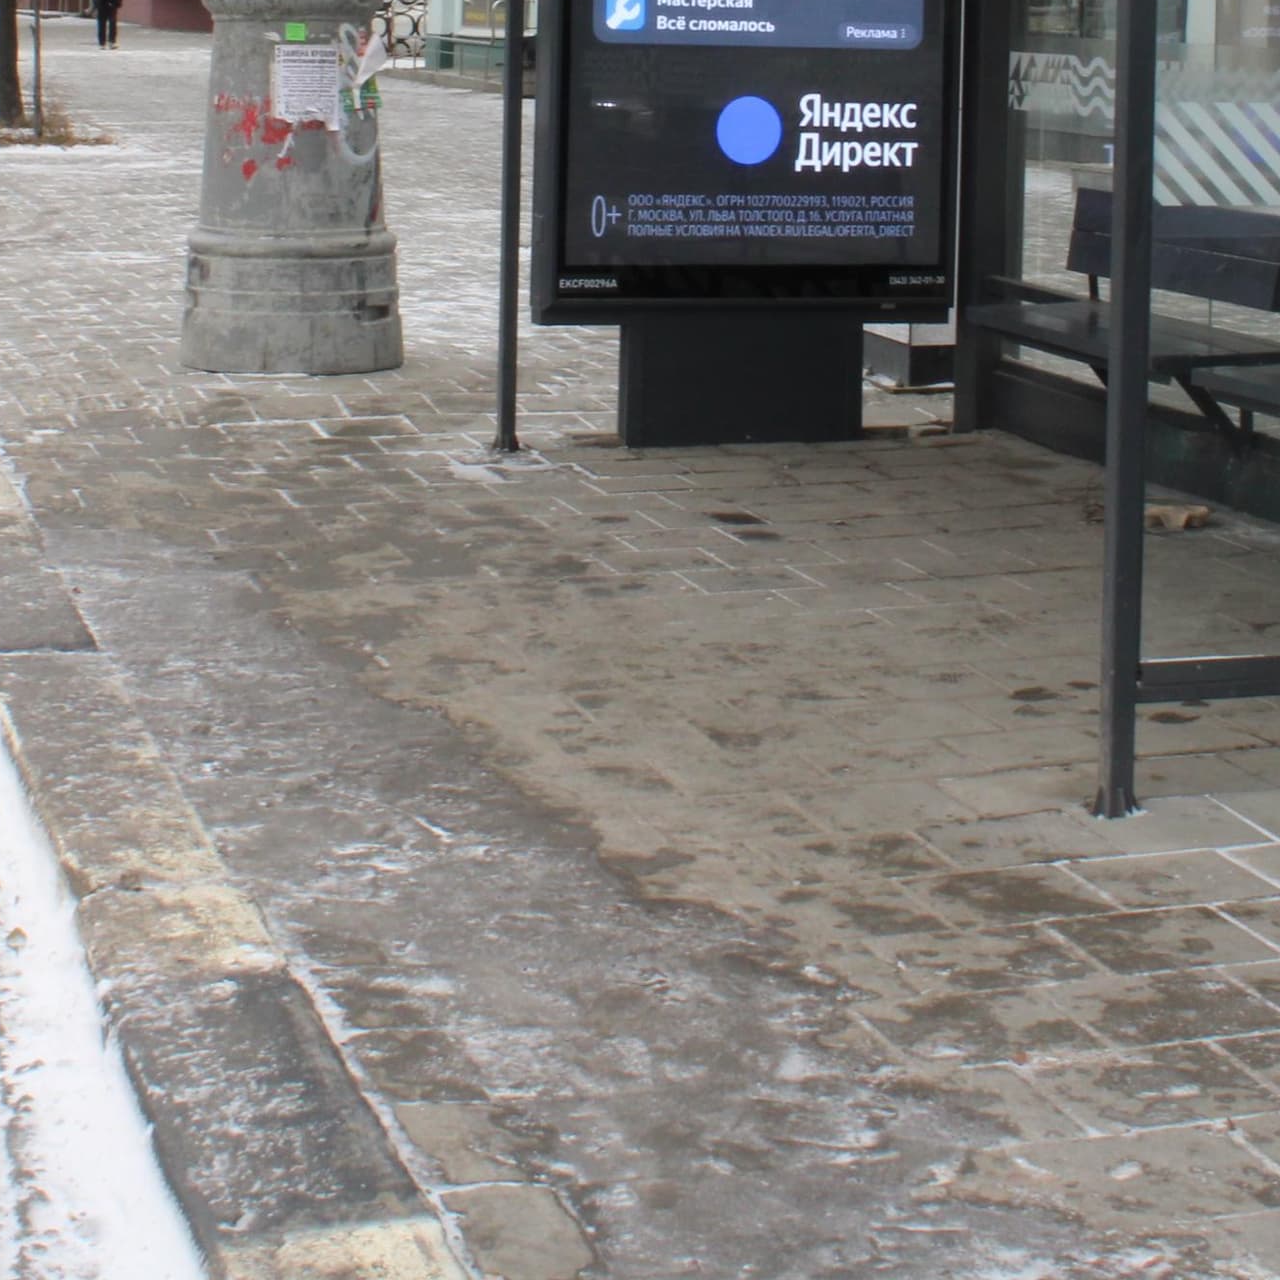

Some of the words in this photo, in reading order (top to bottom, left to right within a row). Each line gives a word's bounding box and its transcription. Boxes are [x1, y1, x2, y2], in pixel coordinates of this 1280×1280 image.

[656, 15, 686, 30] Всё
[689, 18, 775, 33] сломалось
[846, 26, 898, 39] Реклама
[799, 93, 917, 132] Яндекс
[794, 133, 919, 172] Директ
[628, 194, 653, 207] ООО
[716, 194, 745, 207] ОГРН
[591, 195, 622, 237] 0+
[628, 224, 672, 237] ПОЛНЫЕ
[675, 224, 724, 237] УСЛОВИЯ
